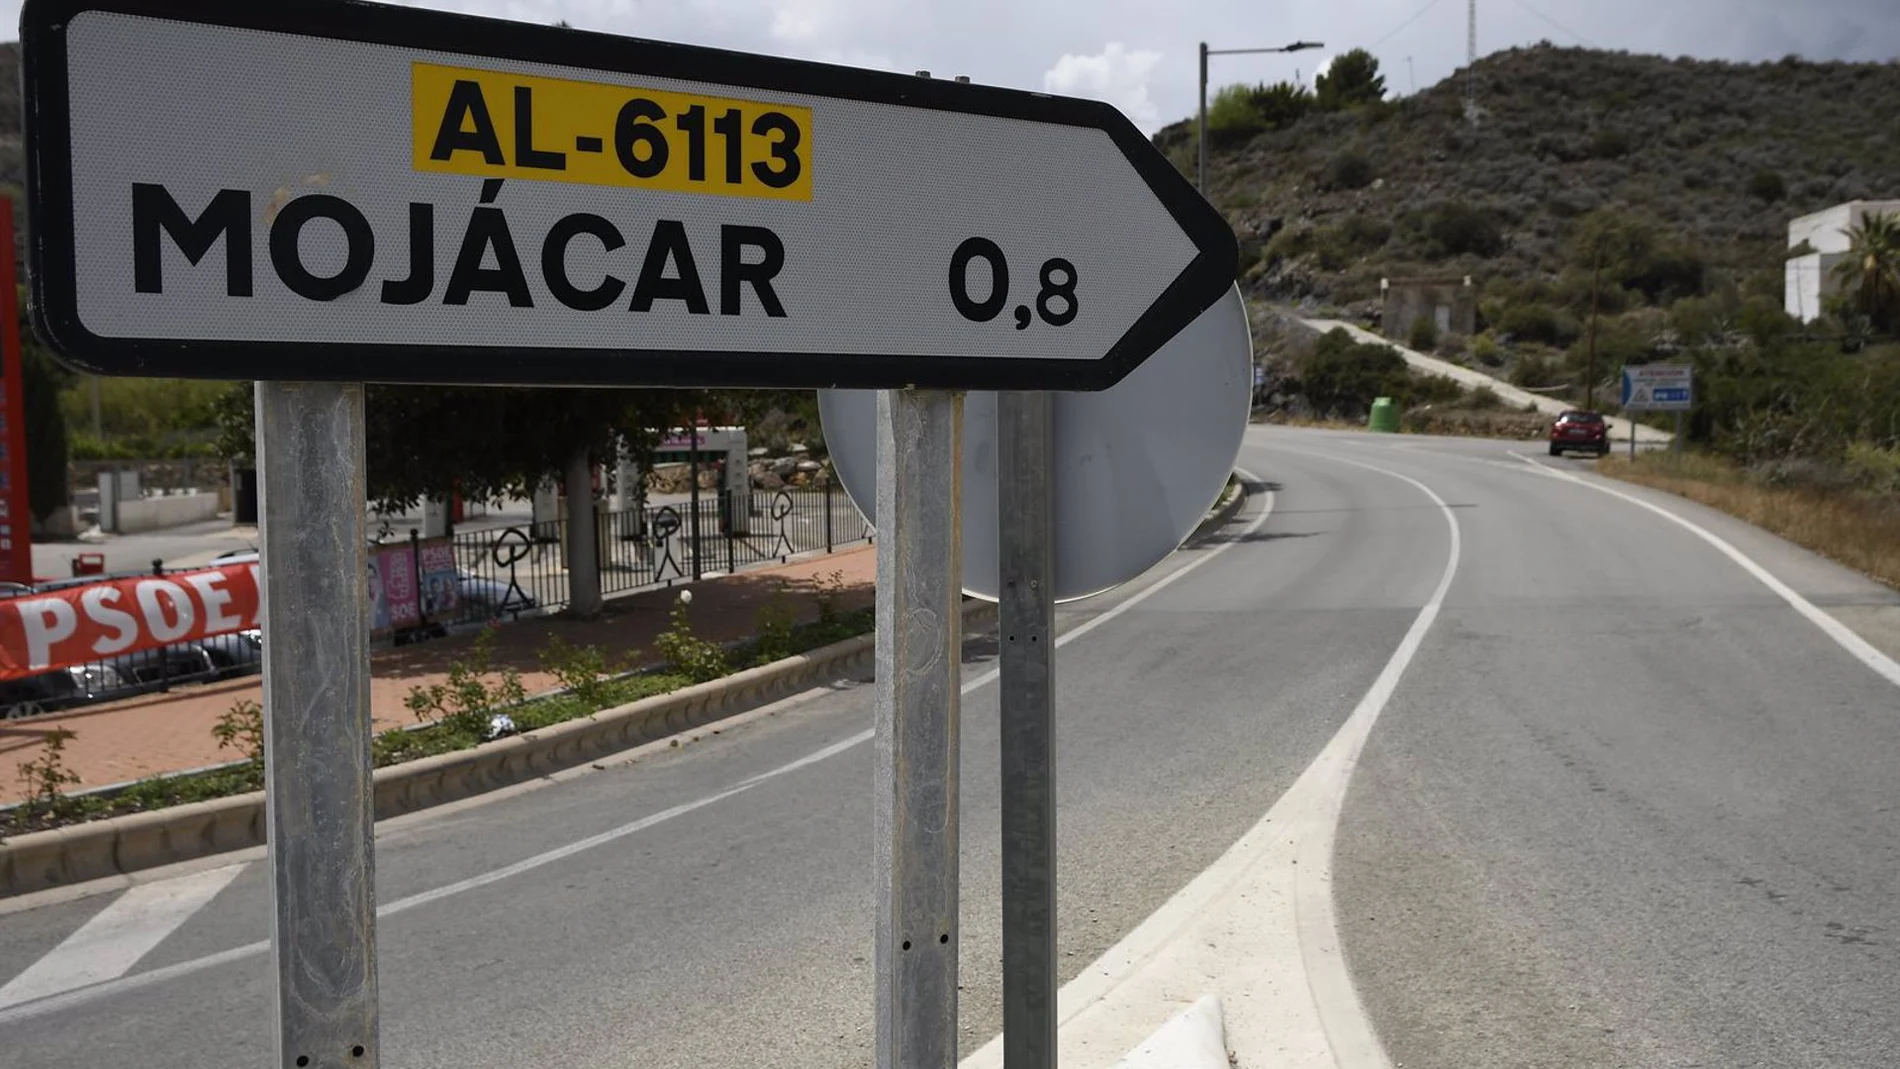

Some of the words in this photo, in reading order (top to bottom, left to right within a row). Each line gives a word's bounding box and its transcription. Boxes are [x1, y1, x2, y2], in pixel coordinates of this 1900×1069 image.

[430, 80, 802, 189] AL-6113
[132, 179, 788, 317] MOJÁCAR
[949, 236, 1079, 331] 0,8
[16, 570, 242, 670] PSOE
